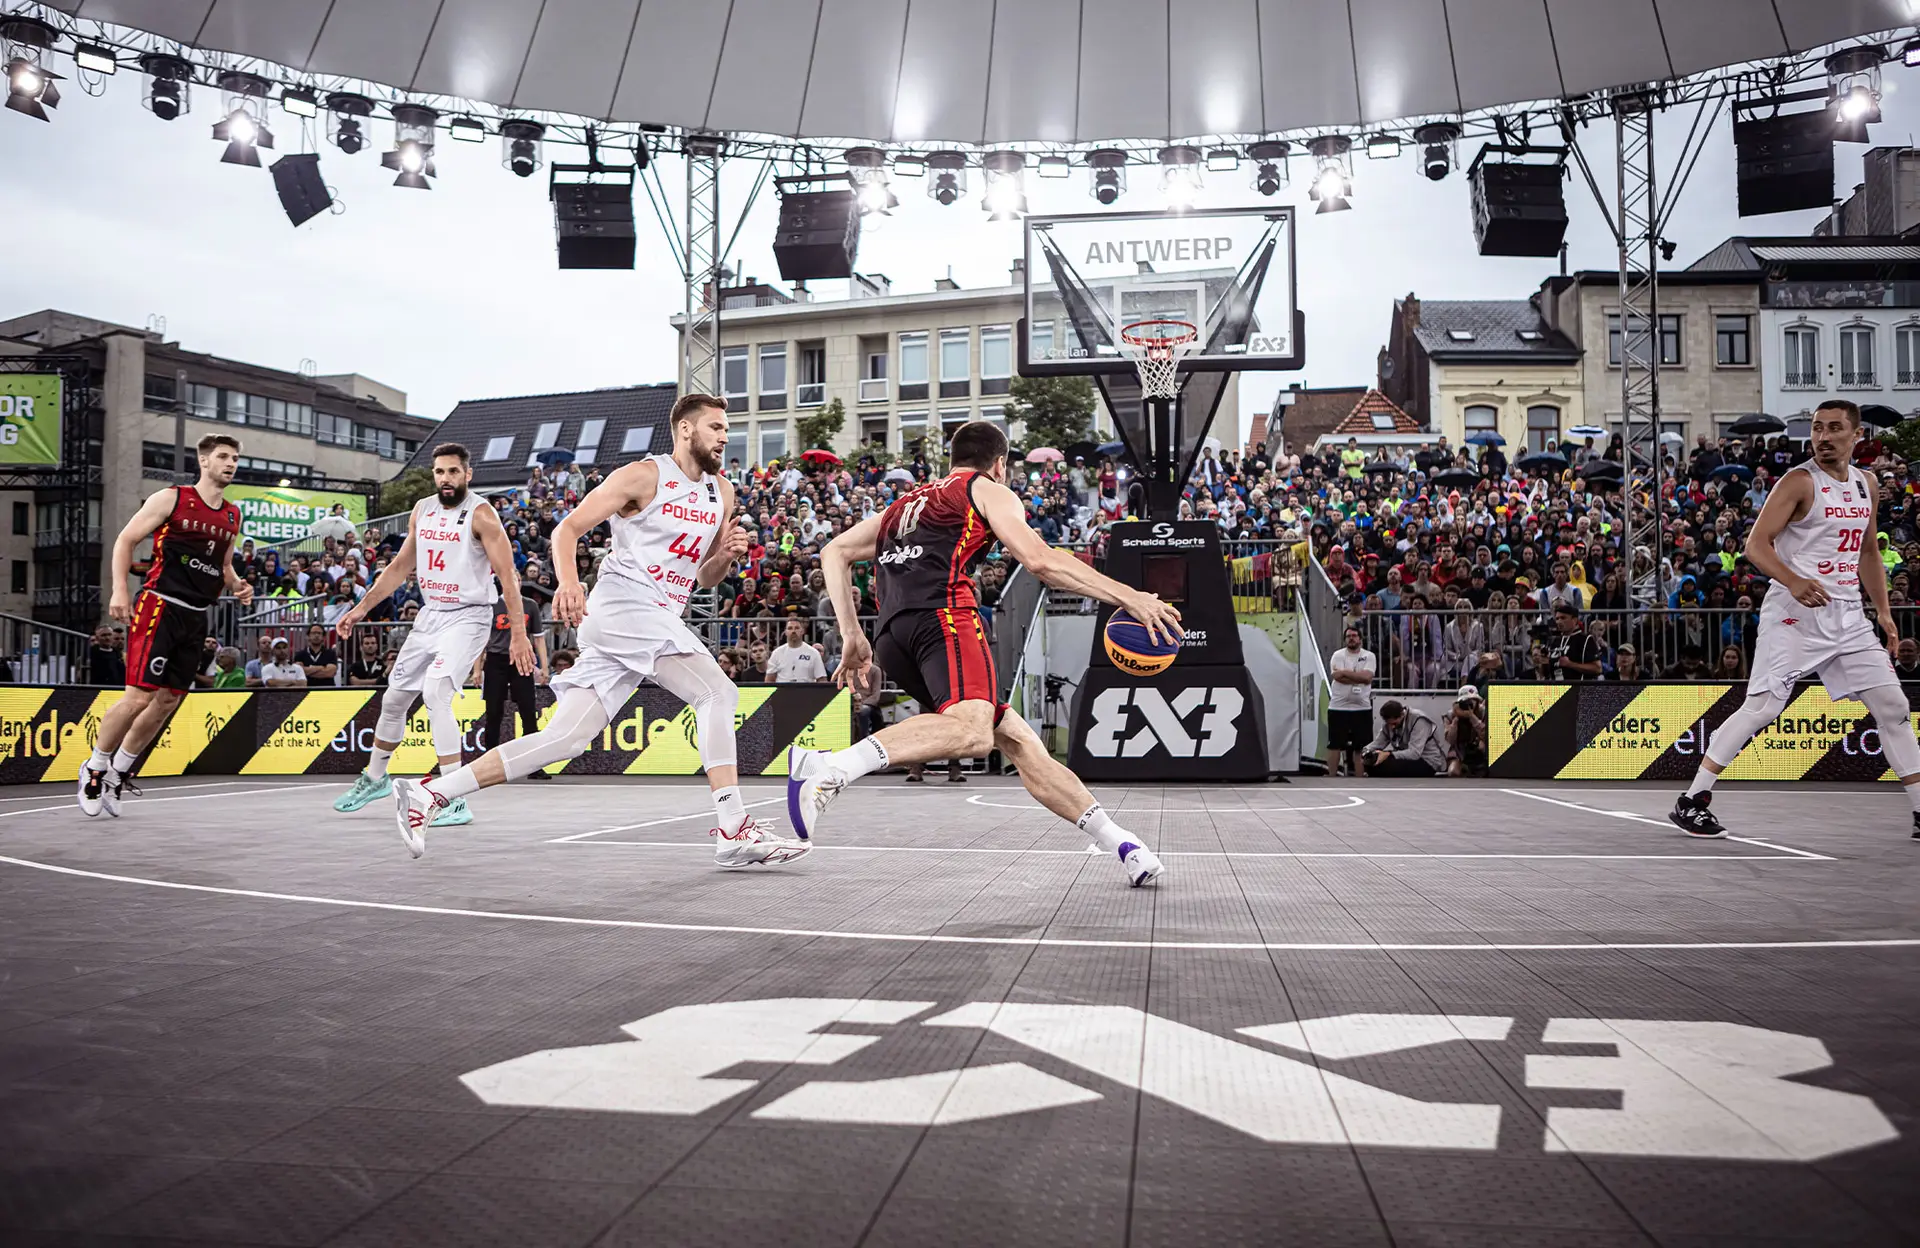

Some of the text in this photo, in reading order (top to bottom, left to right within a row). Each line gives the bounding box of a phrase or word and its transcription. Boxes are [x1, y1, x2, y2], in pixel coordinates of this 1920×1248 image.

[1085, 237, 1233, 264] ANTWERP
[233, 500, 310, 520] THANKS
[662, 503, 716, 526] POLSKA
[1825, 507, 1870, 518] POLSKA
[419, 529, 461, 542] POLSKA
[1122, 538, 1166, 546] Schelde
[1168, 537, 1206, 547] Sports
[668, 533, 702, 564] 44
[189, 558, 220, 577] Crelan
[427, 549, 446, 571] 14
[427, 579, 460, 594] Energa
[1112, 648, 1161, 671] Wilson
[274, 737, 284, 748] of
[288, 738, 303, 748] the
[306, 738, 320, 748] Art
[1600, 737, 1613, 749] of
[1618, 737, 1638, 748] the
[1641, 738, 1661, 748] Art
[1764, 738, 1796, 750] State
[1800, 738, 1815, 750] of
